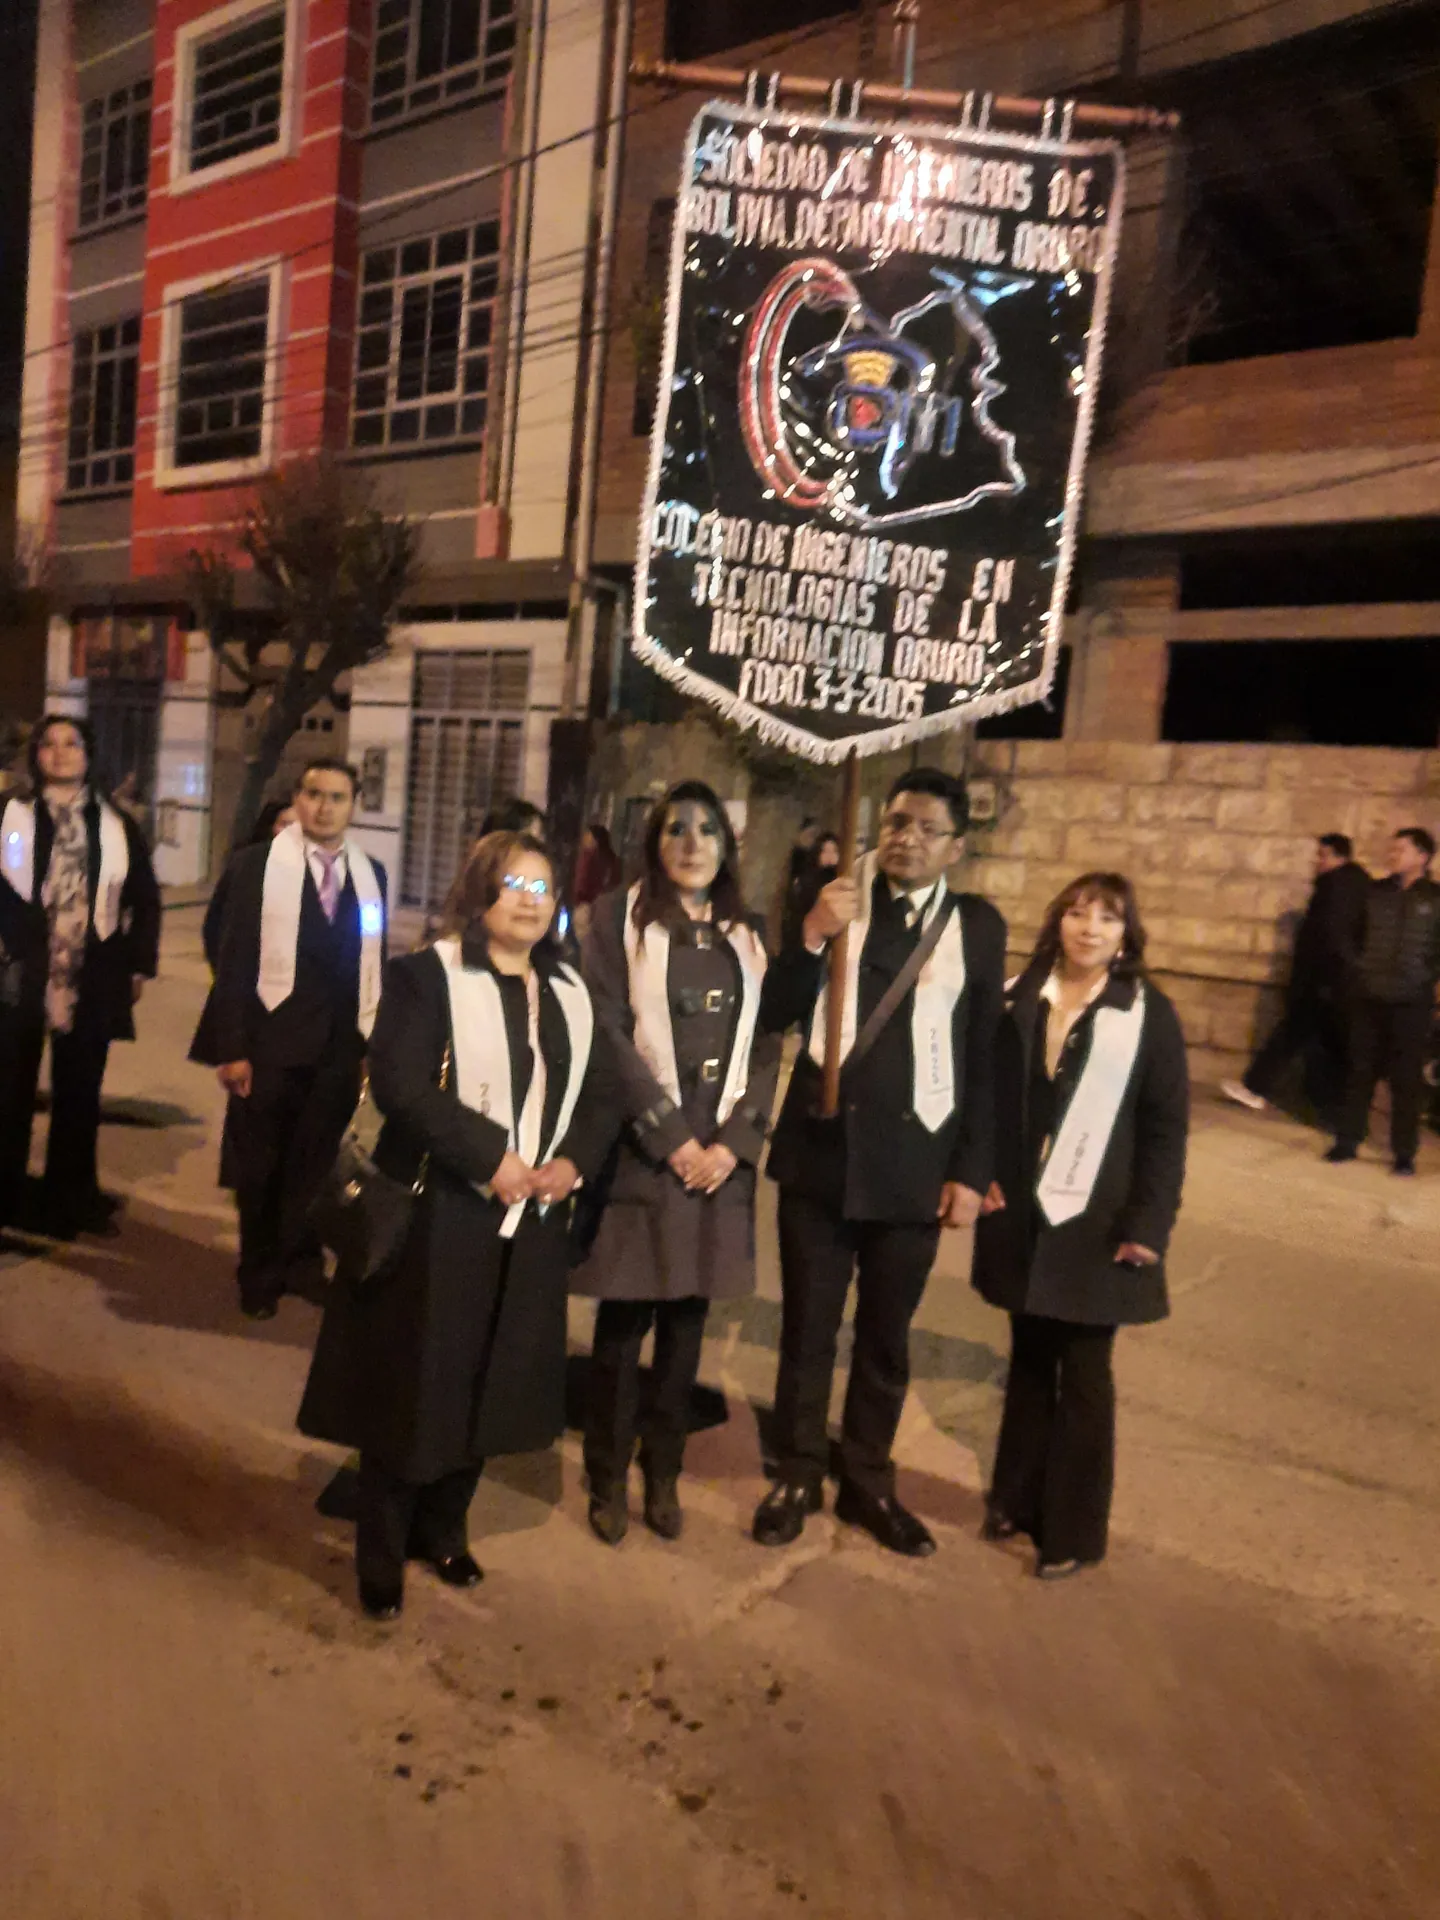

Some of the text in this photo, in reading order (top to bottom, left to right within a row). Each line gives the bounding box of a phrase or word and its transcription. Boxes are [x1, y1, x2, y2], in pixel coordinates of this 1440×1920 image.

[686, 186, 788, 247] BOLIVIA
[837, 146, 874, 194] DE
[1047, 167, 1095, 219] DE
[650, 500, 1017, 605] COLEGIO DE INGENIEROS EN
[693, 561, 998, 645] TECNOLOGIAS DE LA
[708, 609, 987, 686] INFORMACION ORURO
